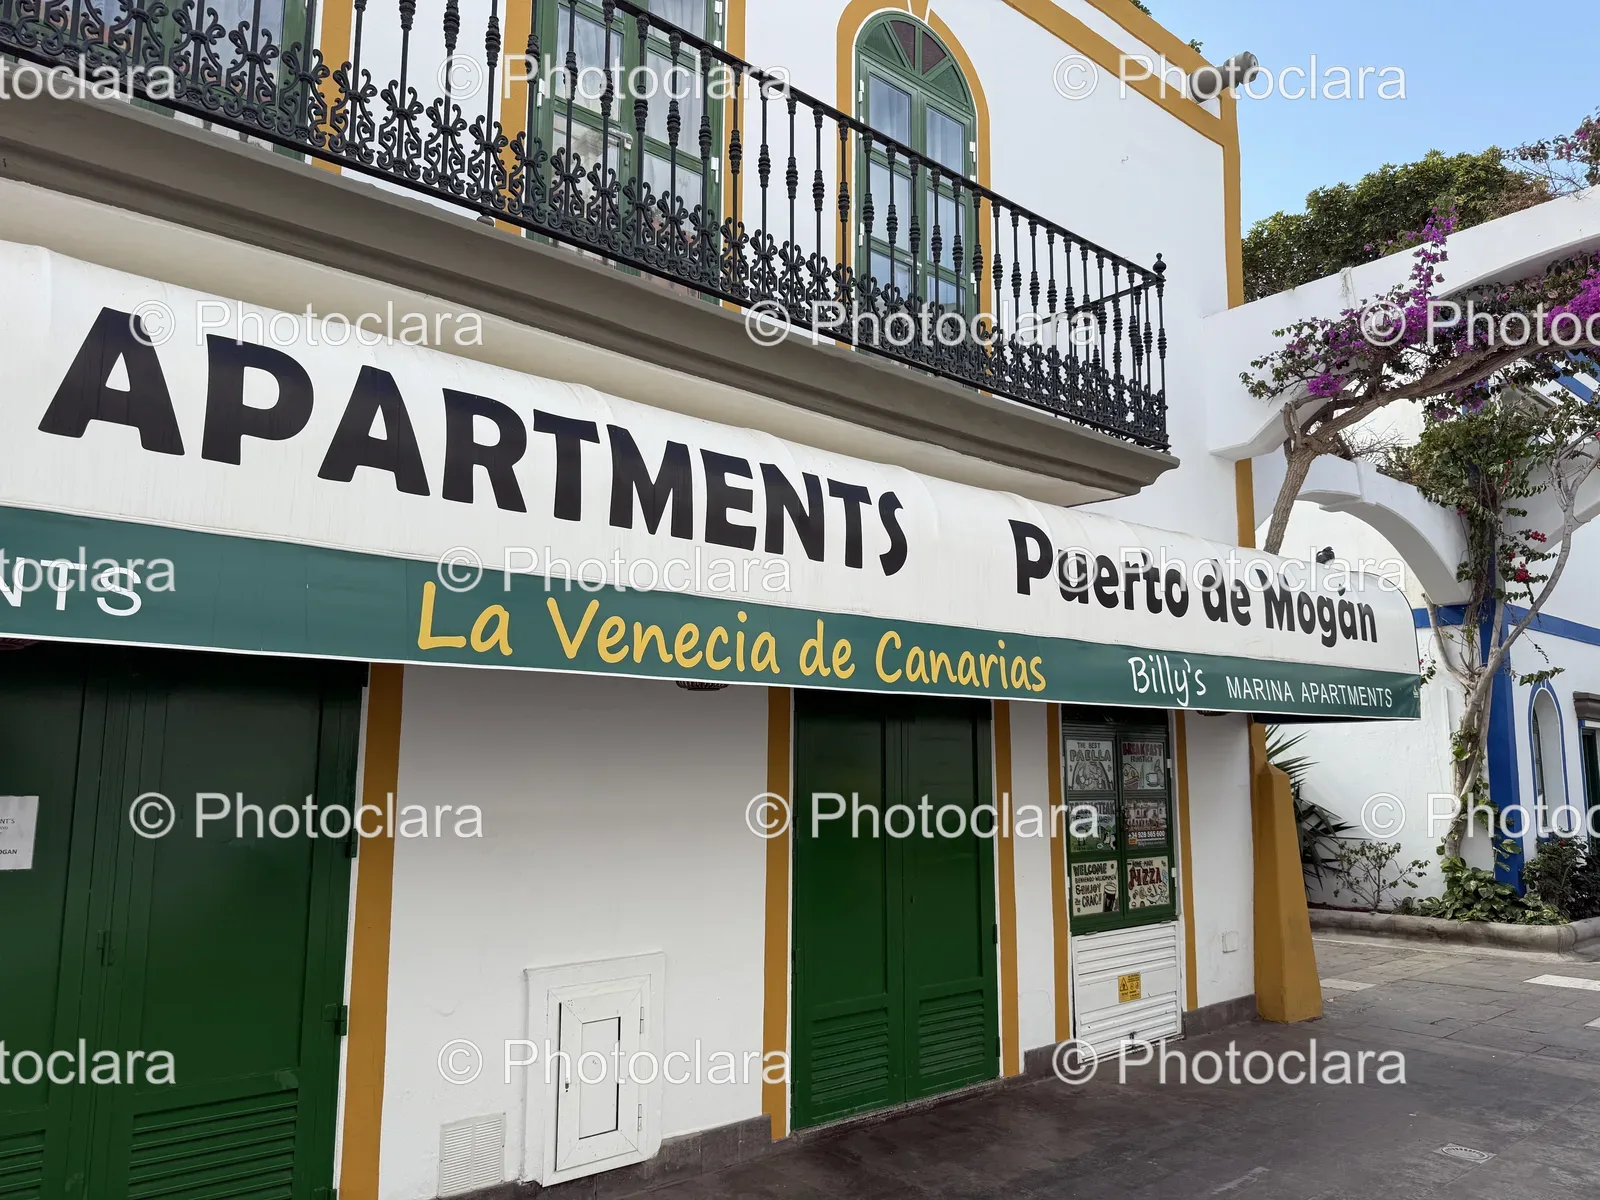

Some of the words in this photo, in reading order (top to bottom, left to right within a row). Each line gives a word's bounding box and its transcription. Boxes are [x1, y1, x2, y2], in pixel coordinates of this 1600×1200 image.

[38, 306, 908, 576] APARTMENTS
[1008, 519, 1189, 618] Puerto
[1202, 558, 1251, 626] de
[1256, 568, 1378, 647] Mogán
[417, 581, 513, 656] La
[547, 597, 780, 674] Venecia
[800, 619, 855, 679] de
[876, 630, 1046, 692] Canarias
[1128, 655, 1207, 707] Billy's
[1226, 675, 1295, 702] MARINA
[1302, 682, 1393, 708] APARTMENTS
[1069, 749, 1111, 761] PAELLA
[1122, 743, 1163, 756] BREAKFAST
[1073, 862, 1107, 876] WELCOME
[1128, 866, 1162, 890] PIZZA
